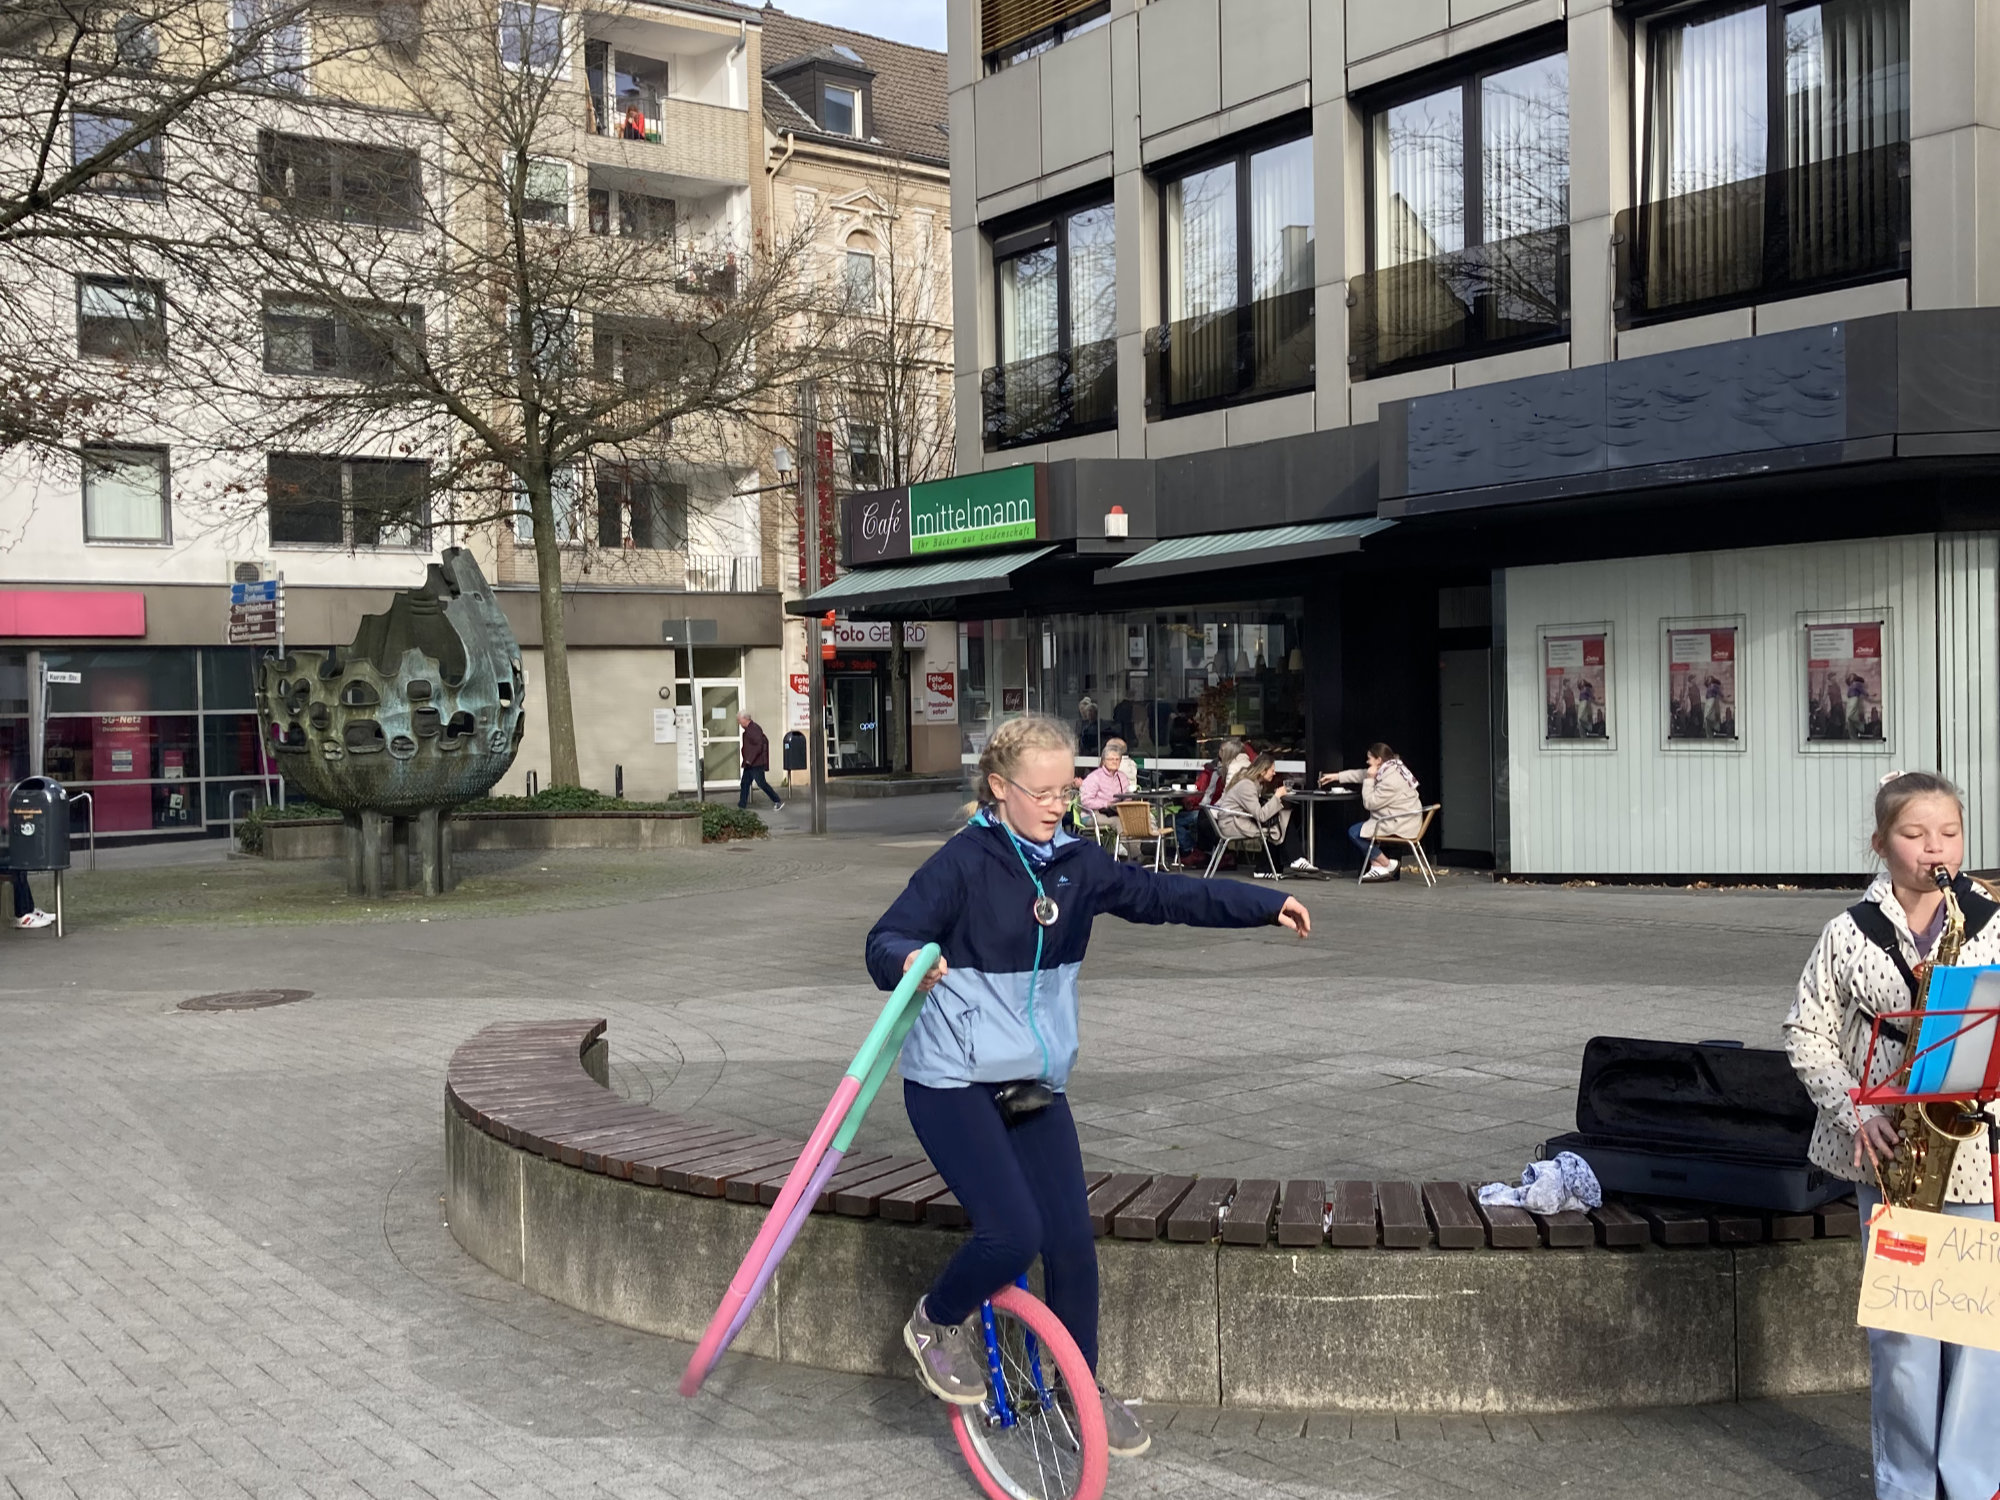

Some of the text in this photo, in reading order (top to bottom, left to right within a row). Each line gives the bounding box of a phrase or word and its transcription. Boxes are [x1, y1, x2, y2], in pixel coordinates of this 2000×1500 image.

[862, 498, 1030, 554] Café mittelmann
[917, 526, 1030, 550] Ihr Bäcker aus Leidenschaft
[245, 613, 263, 622] Forum
[251, 623, 260, 631] und
[834, 625, 865, 642] Foto
[869, 625, 926, 642] GERD
[851, 659, 877, 670] Studio
[49, 673, 66, 681] Kurze
[794, 676, 809, 684] Foto
[928, 675, 945, 683] Foto-
[798, 685, 809, 693] Stu
[931, 682, 952, 691] Studio
[101, 715, 142, 724] 5G-Netz
[1938, 1227, 2000, 1263] Akti
[1864, 1275, 2000, 1321] Straßenk
